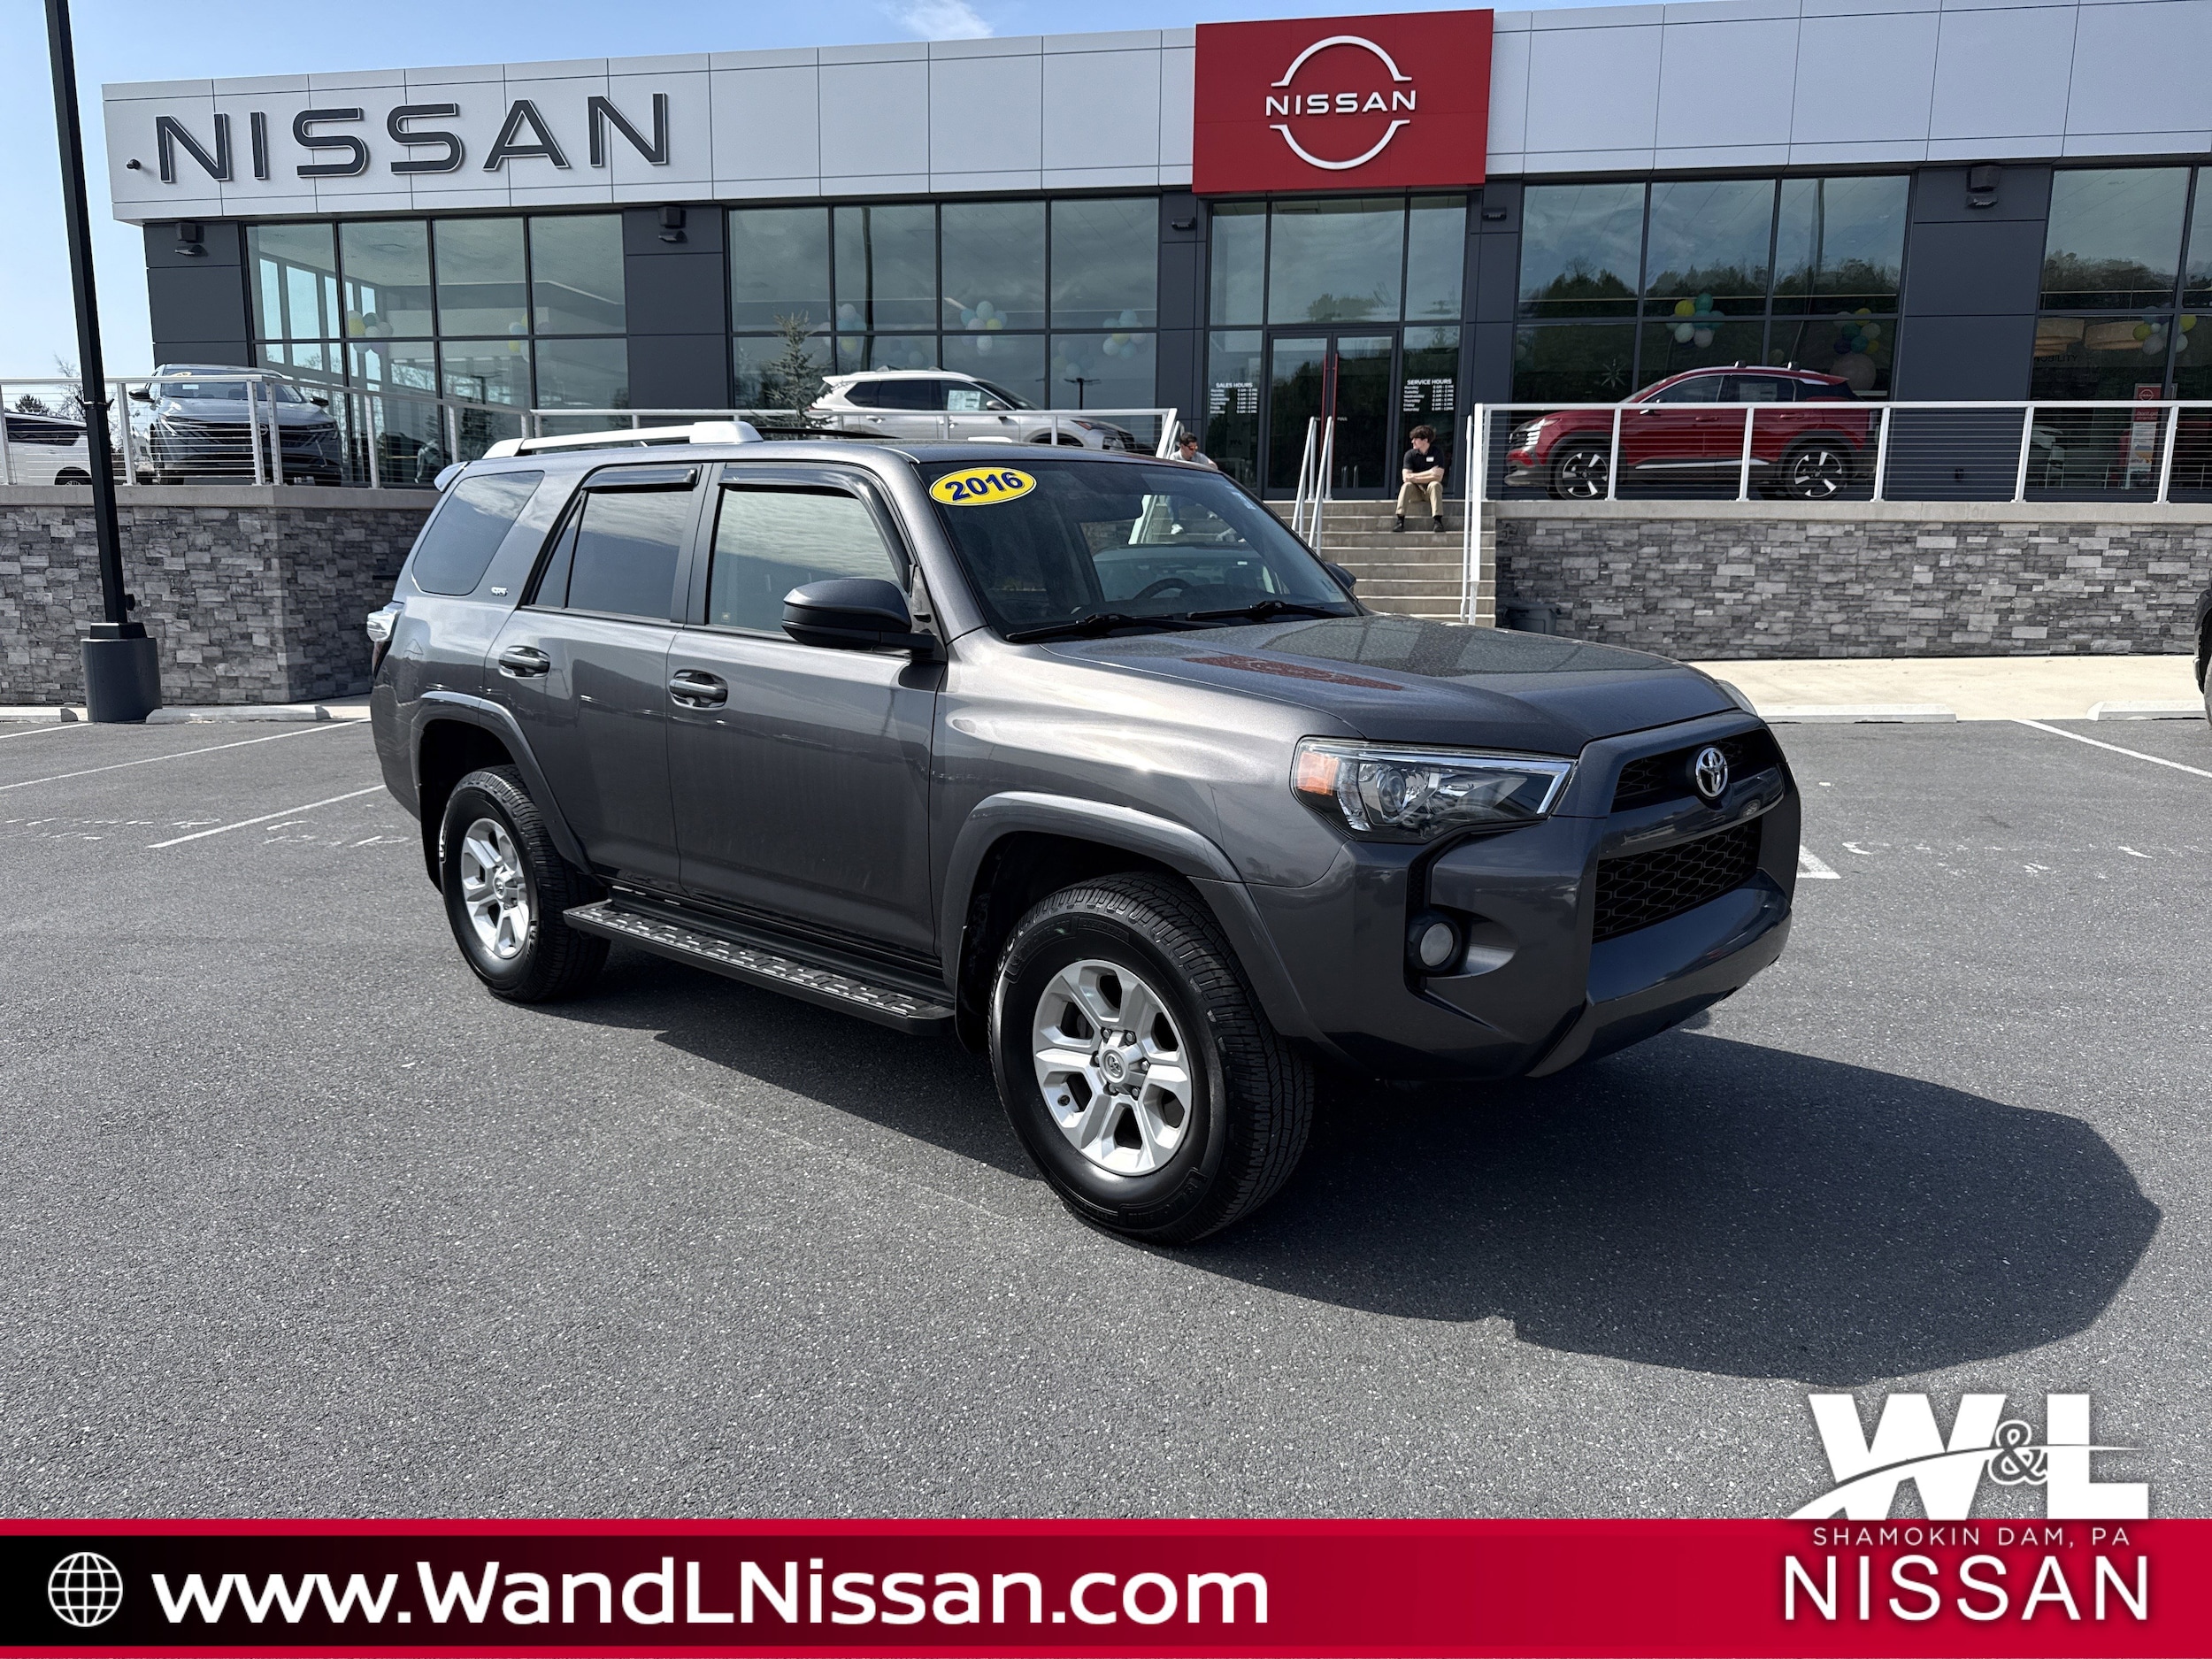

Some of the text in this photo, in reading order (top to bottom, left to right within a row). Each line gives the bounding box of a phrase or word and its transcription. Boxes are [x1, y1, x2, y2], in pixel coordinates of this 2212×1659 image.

[1265, 90, 1416, 117] NISSAN
[155, 92, 669, 183] NISSAN
[945, 472, 1024, 502] 2016
